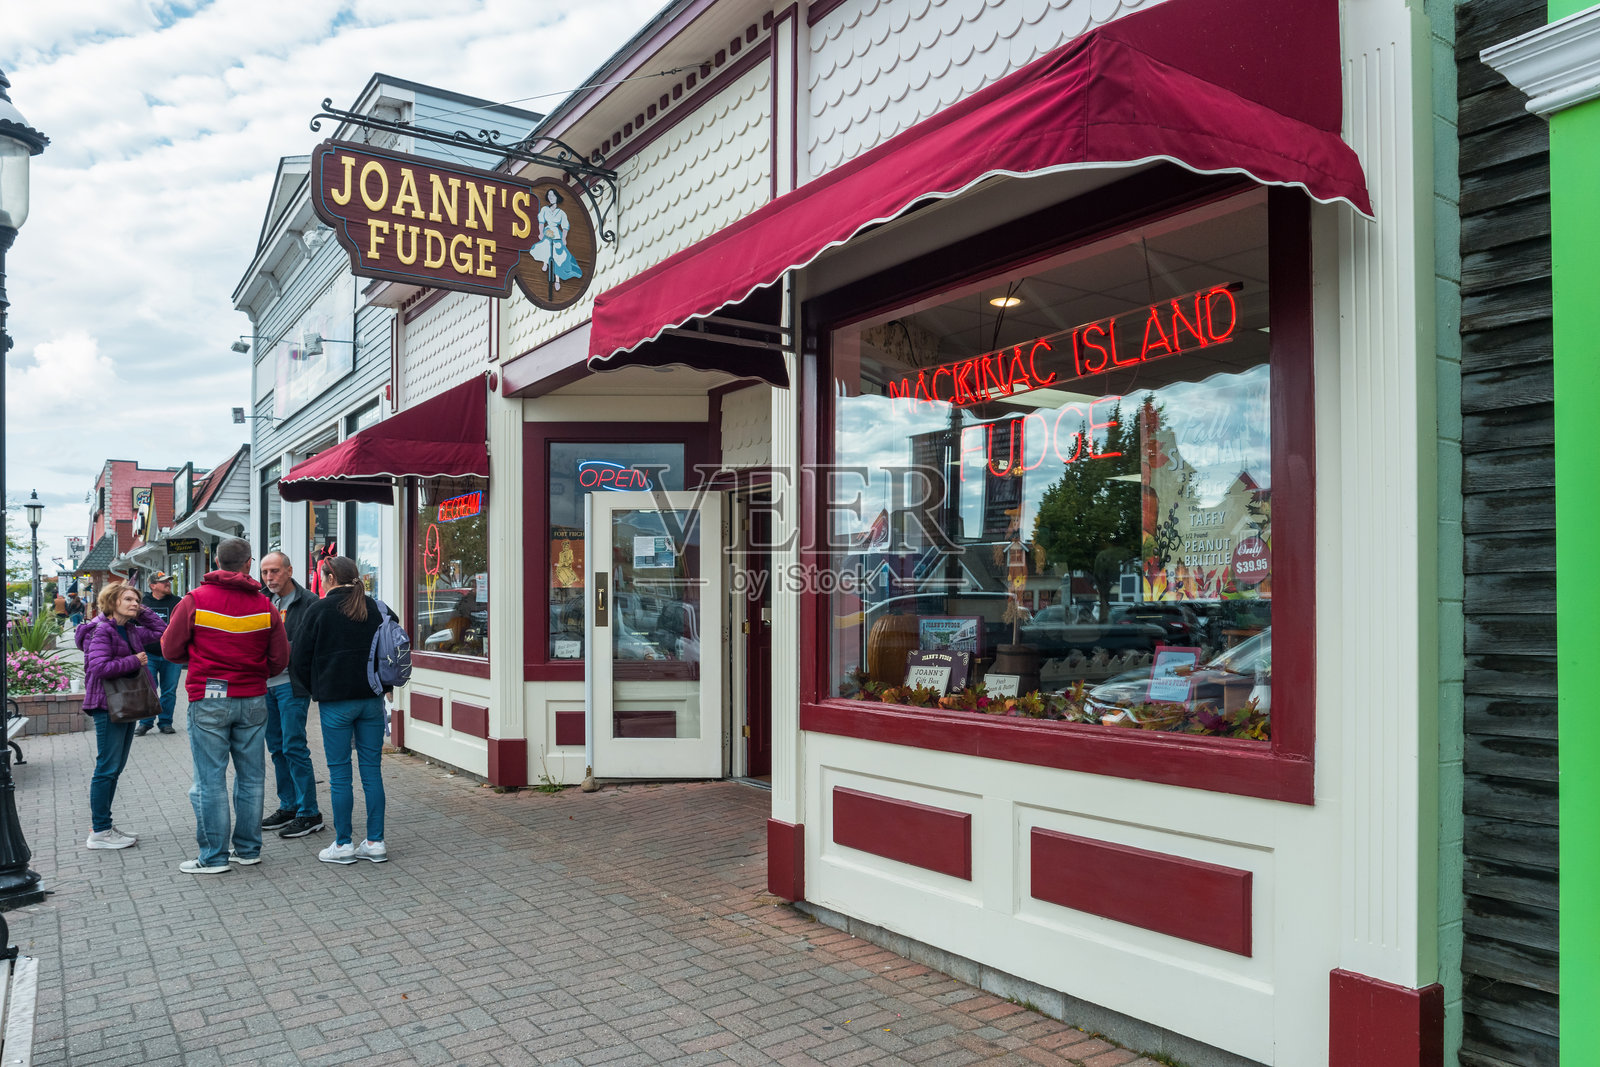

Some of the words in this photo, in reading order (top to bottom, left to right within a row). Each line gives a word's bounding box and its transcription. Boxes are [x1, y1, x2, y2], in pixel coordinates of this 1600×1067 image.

[331, 155, 531, 239] JOANN'S
[367, 218, 497, 278] FUDGE
[889, 337, 1056, 415] MACKINAC
[1072, 287, 1237, 376] ISLAND
[959, 396, 1122, 482] FUDGE
[579, 468, 649, 488] OPEN
[1190, 511, 1226, 526] TAFFY
[1185, 538, 1231, 553] PEANUT
[1237, 541, 1263, 558] Only
[1185, 552, 1232, 567] BRITTLE
[1236, 558, 1268, 574] $39.95
[915, 668, 944, 677] JOANN'S
